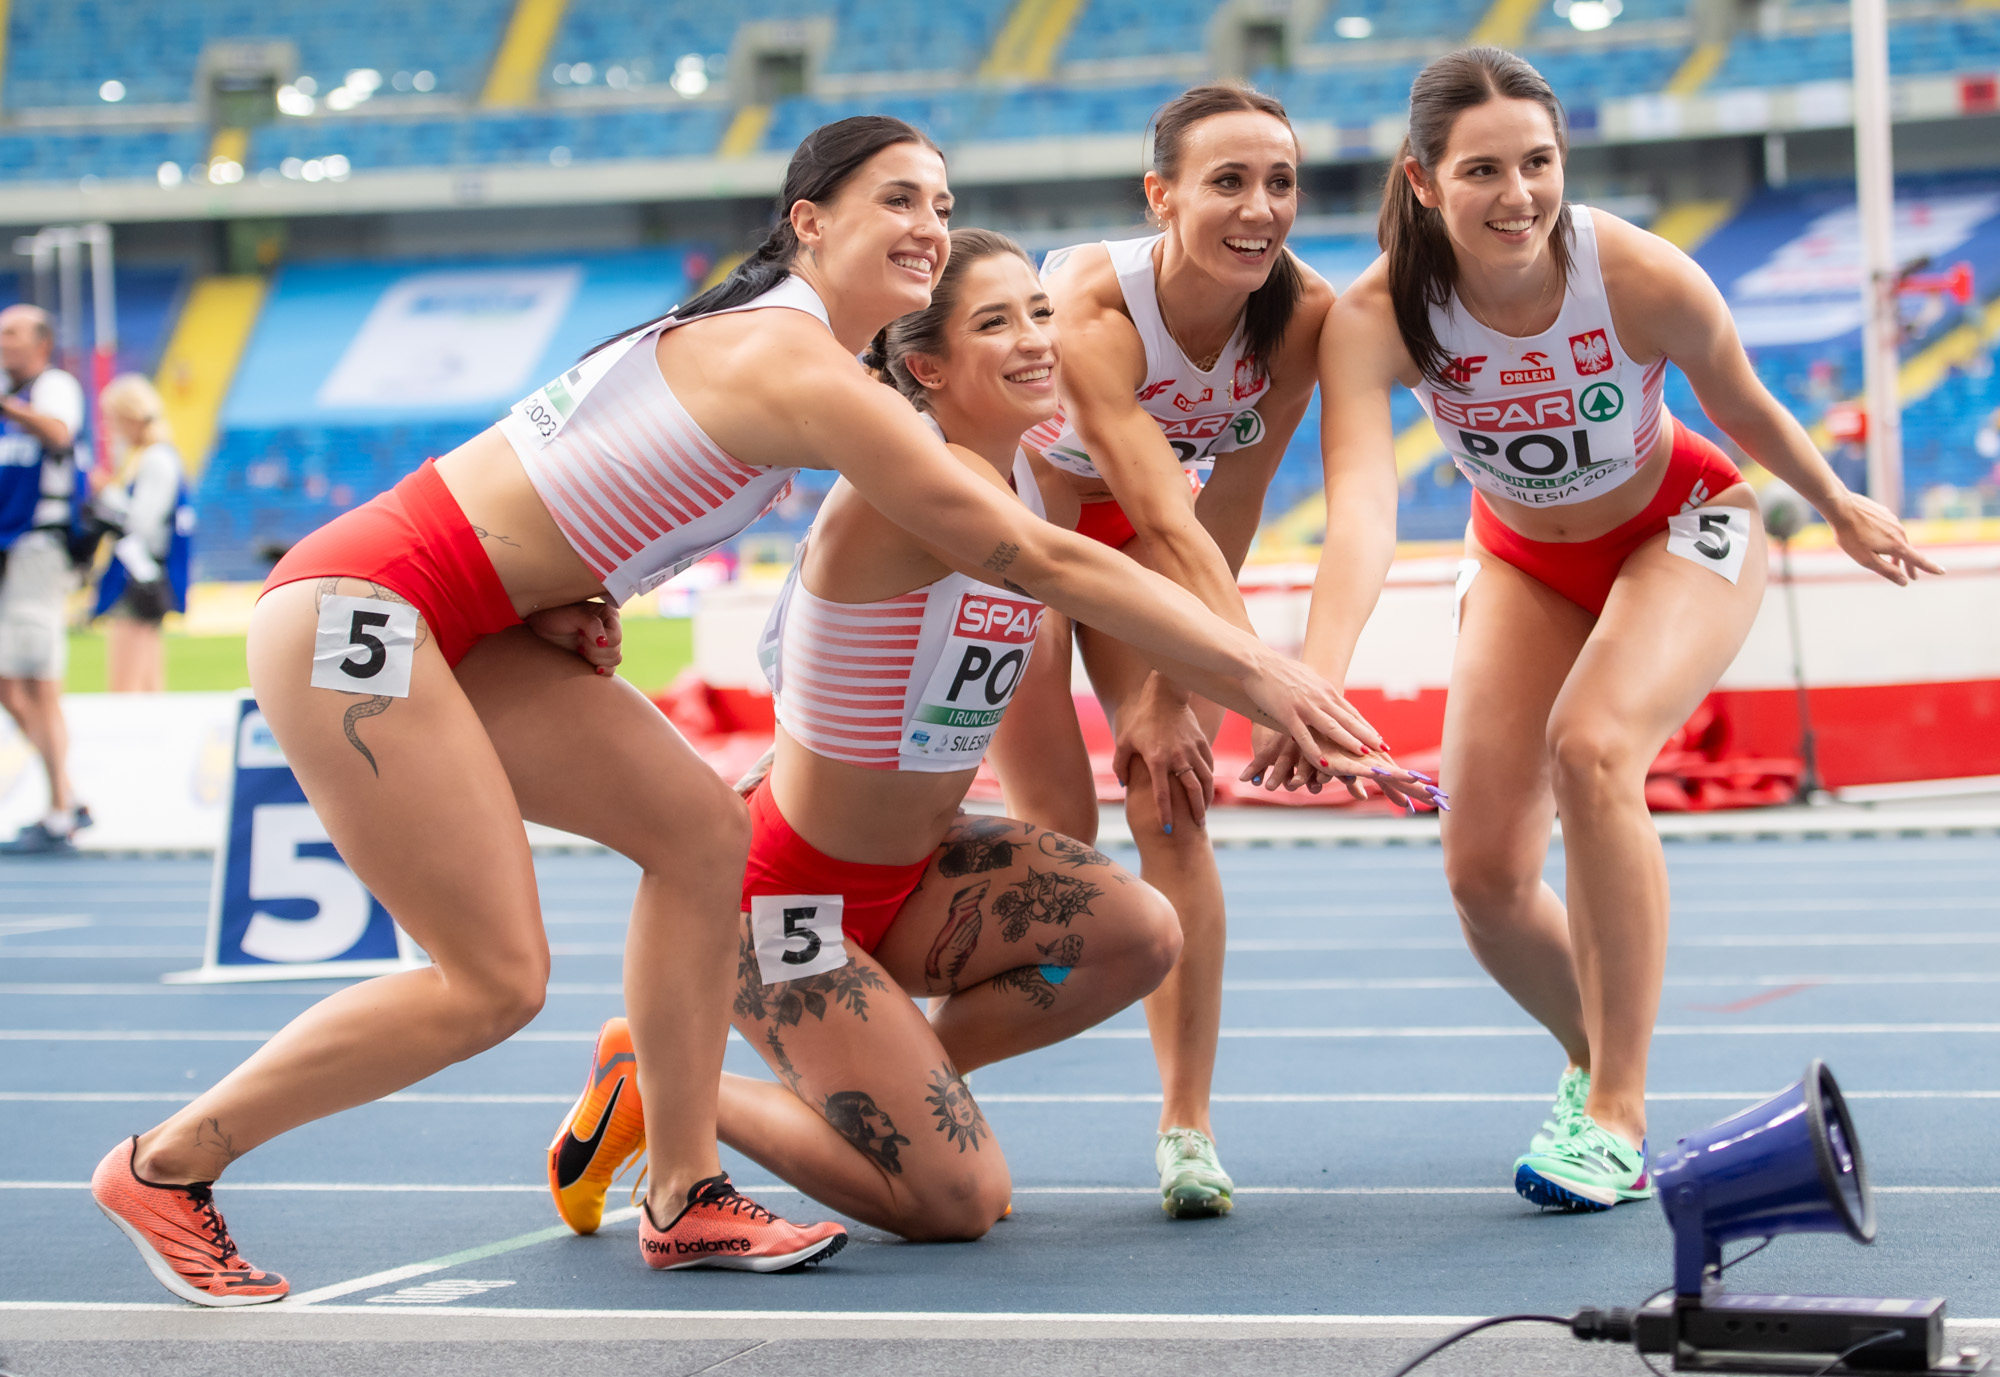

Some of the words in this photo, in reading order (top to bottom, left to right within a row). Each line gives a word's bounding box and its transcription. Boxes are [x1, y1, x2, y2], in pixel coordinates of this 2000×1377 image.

[1503, 369, 1551, 384] ORLEN
[1175, 390, 1212, 411] ORN
[1436, 395, 1571, 429] SPAR
[1161, 416, 1227, 436] AR
[1458, 429, 1613, 476] POL
[1492, 468, 1528, 488] RUN
[1531, 467, 1588, 489] CLEAN
[1505, 485, 1580, 504] SILESIA
[1693, 514, 1731, 561] 5
[339, 610, 391, 679] 5
[945, 645, 1033, 706] PO
[948, 711, 955, 724] I
[954, 710, 981, 725] RUN
[980, 709, 1005, 725] CLE
[950, 733, 991, 752] SILESIA
[241, 803, 372, 964] 5
[781, 906, 823, 966] 5
[642, 1238, 671, 1255] new
[674, 1237, 751, 1255] balance
